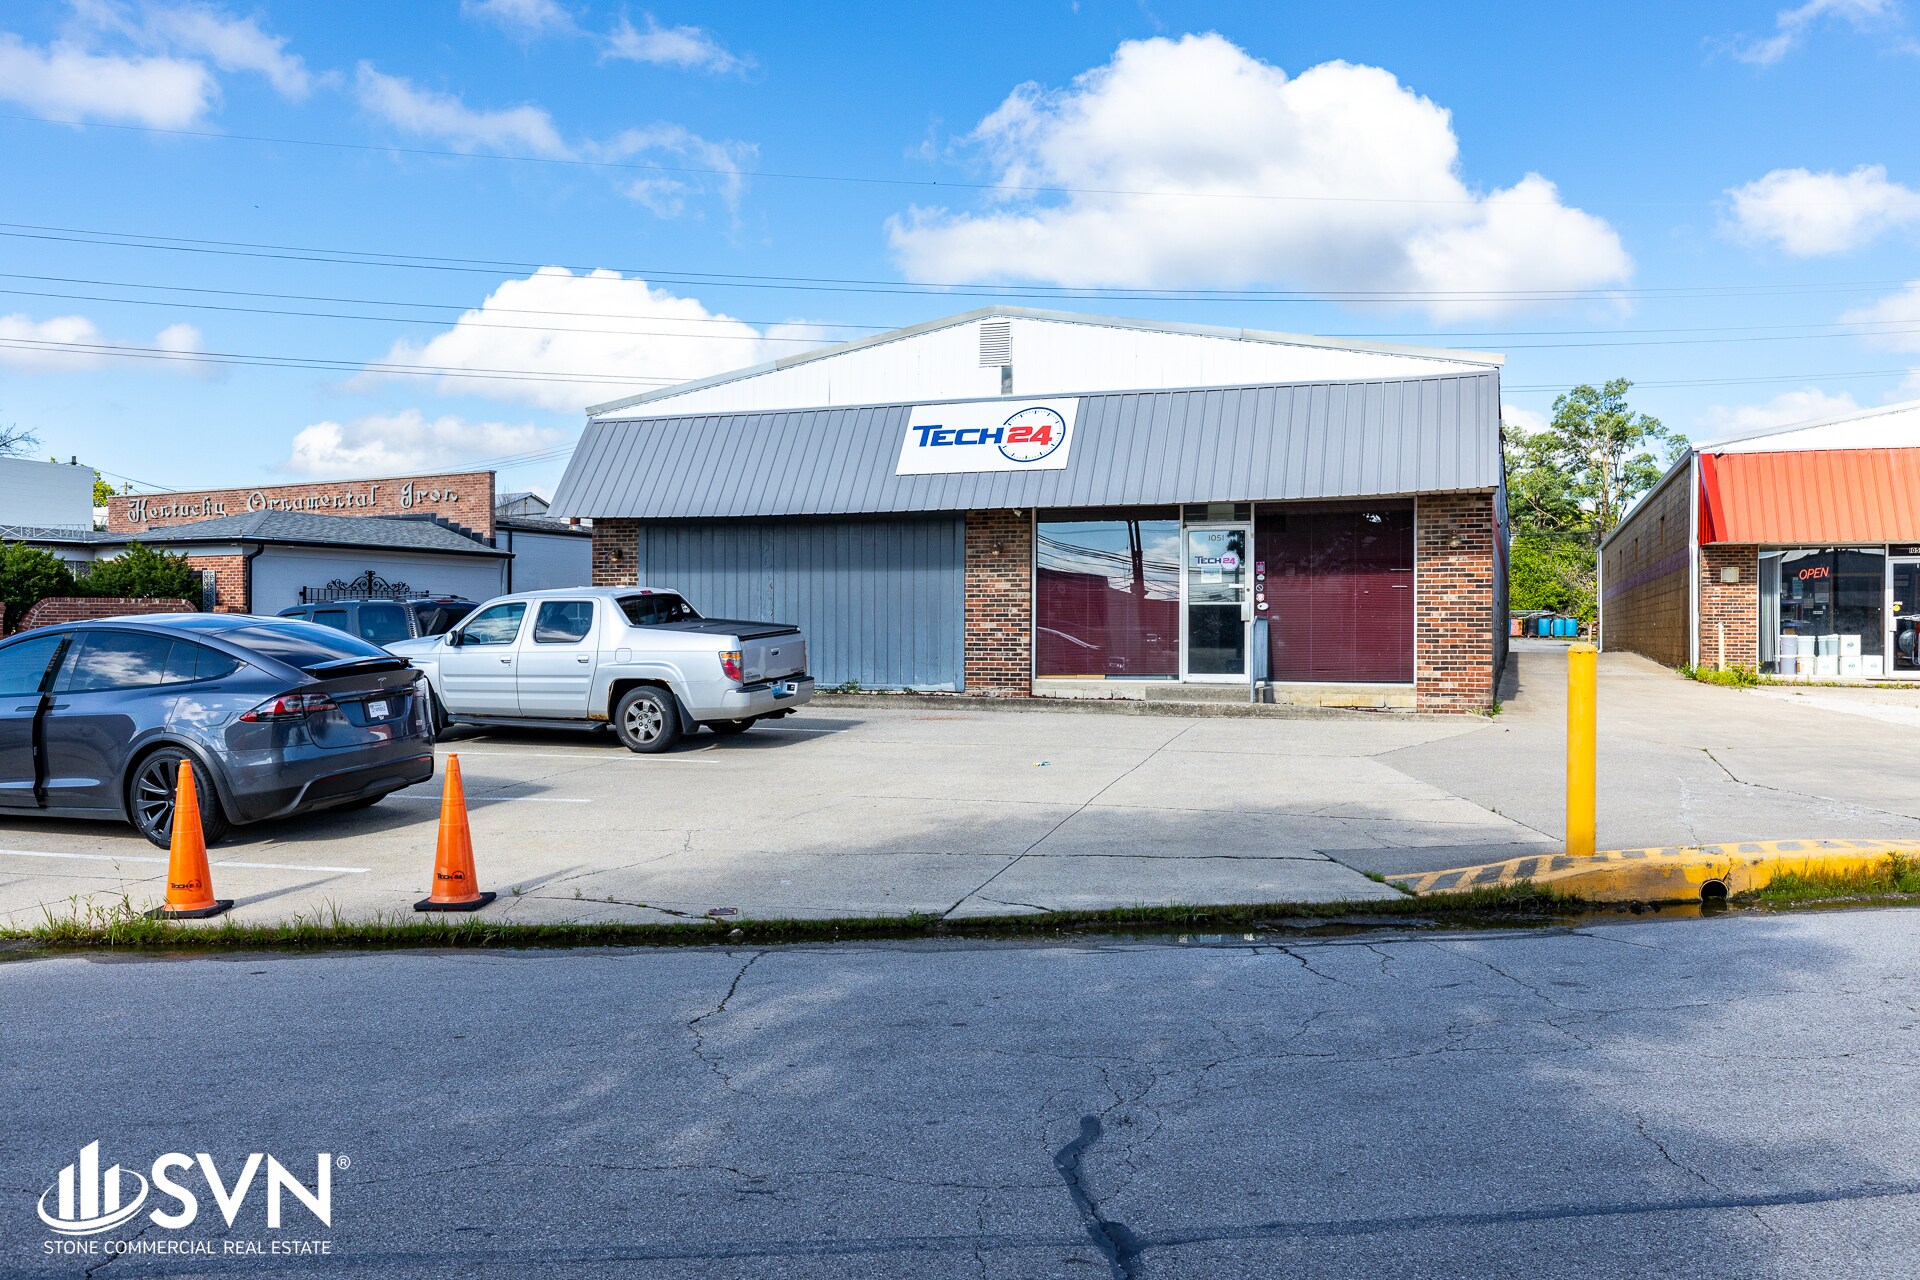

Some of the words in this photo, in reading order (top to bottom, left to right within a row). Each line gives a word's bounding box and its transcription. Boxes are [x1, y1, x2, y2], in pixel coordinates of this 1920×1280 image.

[127, 495, 229, 523] Kentucky
[247, 484, 380, 512] Ornamental
[400, 480, 459, 509] Iron
[1208, 534, 1225, 542] 1051
[1799, 566, 1830, 580] OPEN
